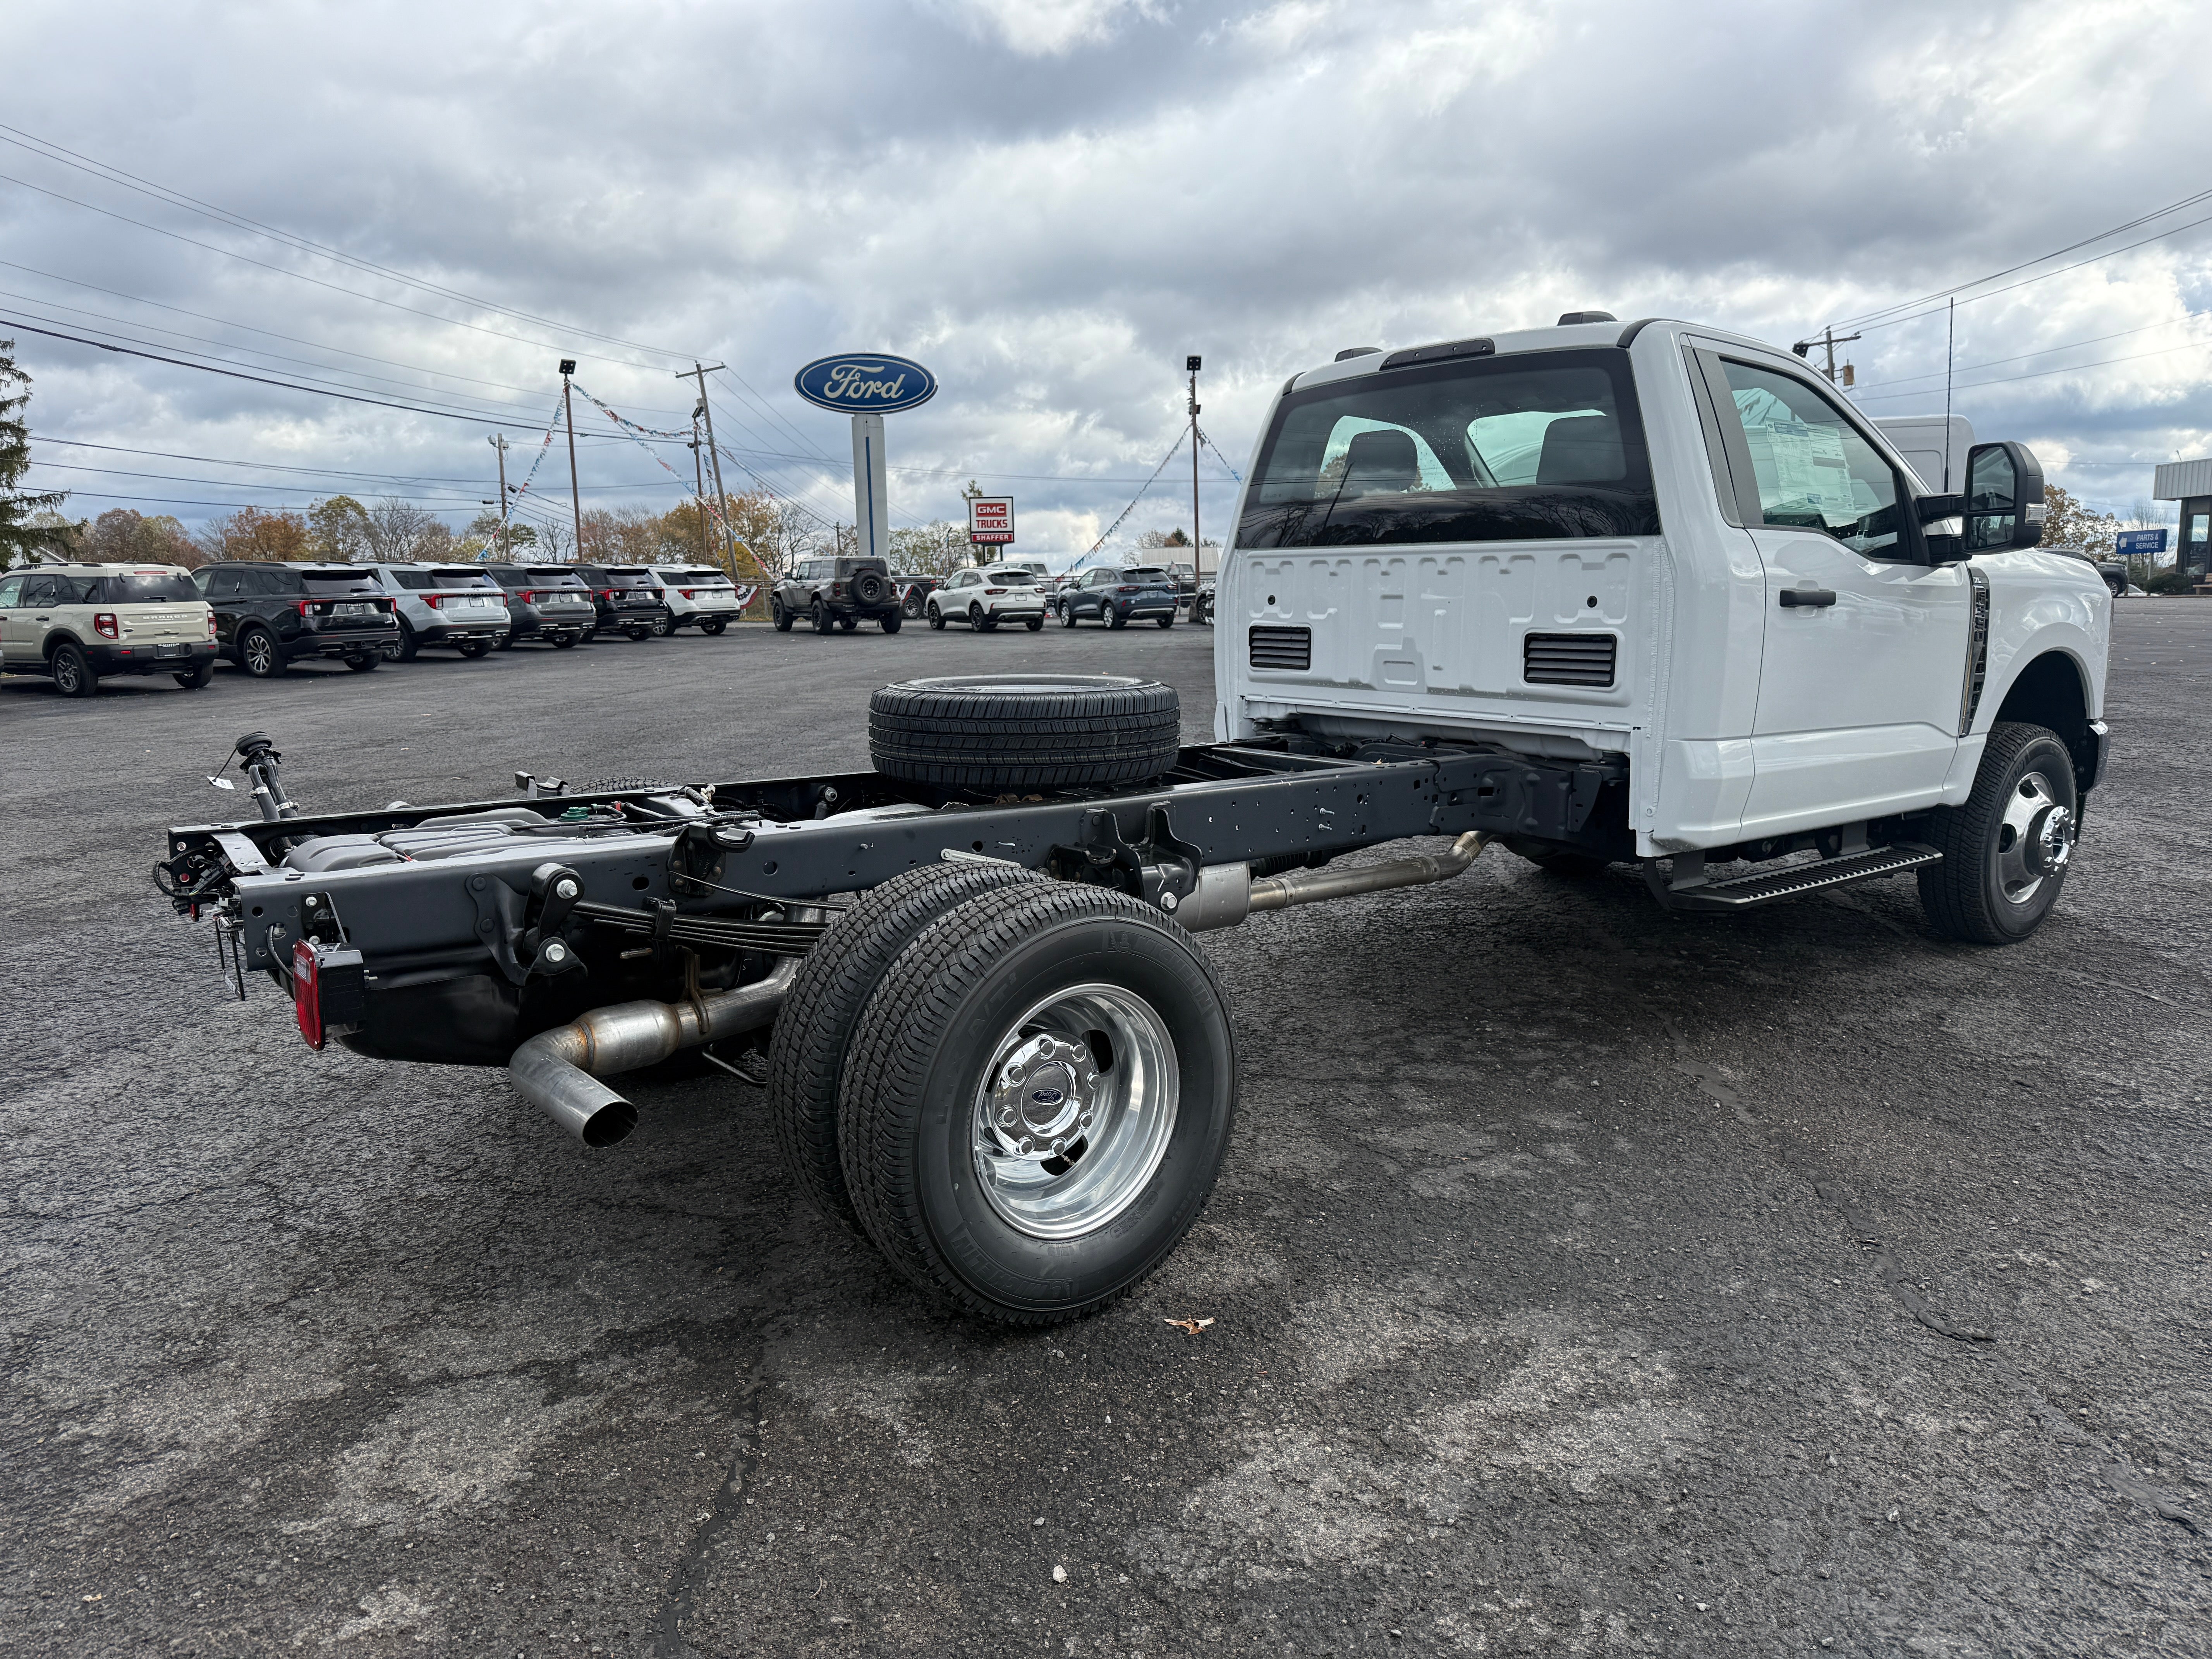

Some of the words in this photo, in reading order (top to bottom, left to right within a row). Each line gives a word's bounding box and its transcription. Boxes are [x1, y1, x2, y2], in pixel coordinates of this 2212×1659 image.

[824, 364, 905, 398] Ford
[976, 519, 1008, 528] TRUCKS
[1132, 936, 1213, 1010] MICHELIN
[1038, 1091, 1057, 1101] Ford
